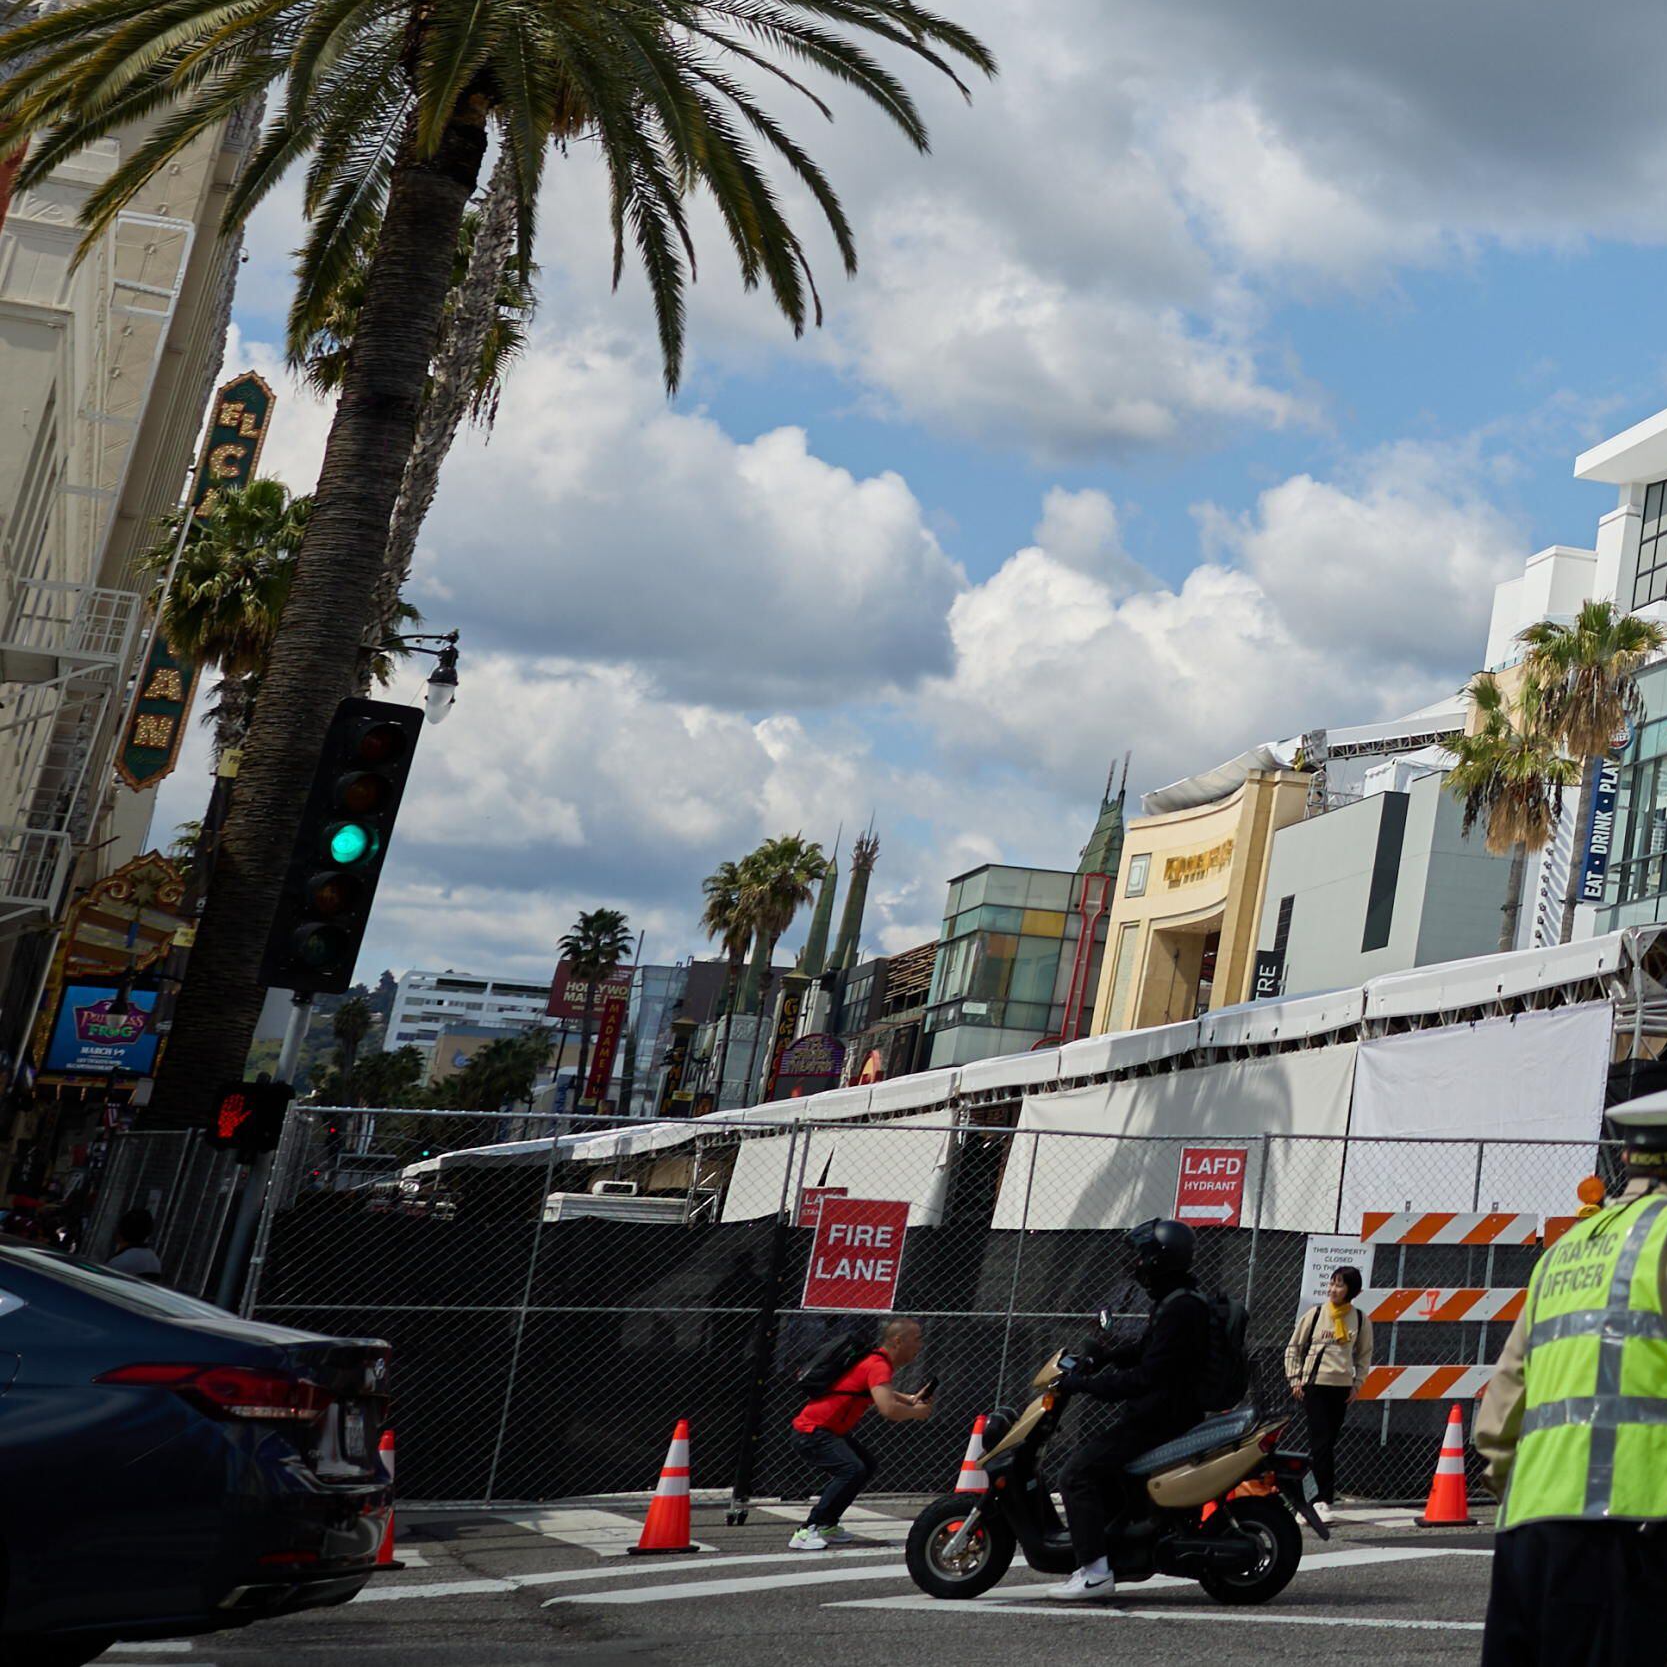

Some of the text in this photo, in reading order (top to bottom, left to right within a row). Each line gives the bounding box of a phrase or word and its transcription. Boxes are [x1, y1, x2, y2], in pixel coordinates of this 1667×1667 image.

[219, 400, 261, 439] EL
[1599, 757, 1621, 794] PLAY
[1590, 810, 1613, 855] DRINK
[1584, 871, 1604, 897] EAT
[597, 1003, 621, 1069] MADAME
[1185, 1157, 1241, 1175] LAFD
[1184, 1181, 1237, 1191] HYDRANT
[828, 1224, 893, 1248] FIRE
[1552, 1233, 1618, 1266] TRAFFIC
[1330, 1247, 1367, 1255] PROPERTY
[815, 1257, 893, 1282] LANE
[1542, 1263, 1606, 1300] OFFICER
